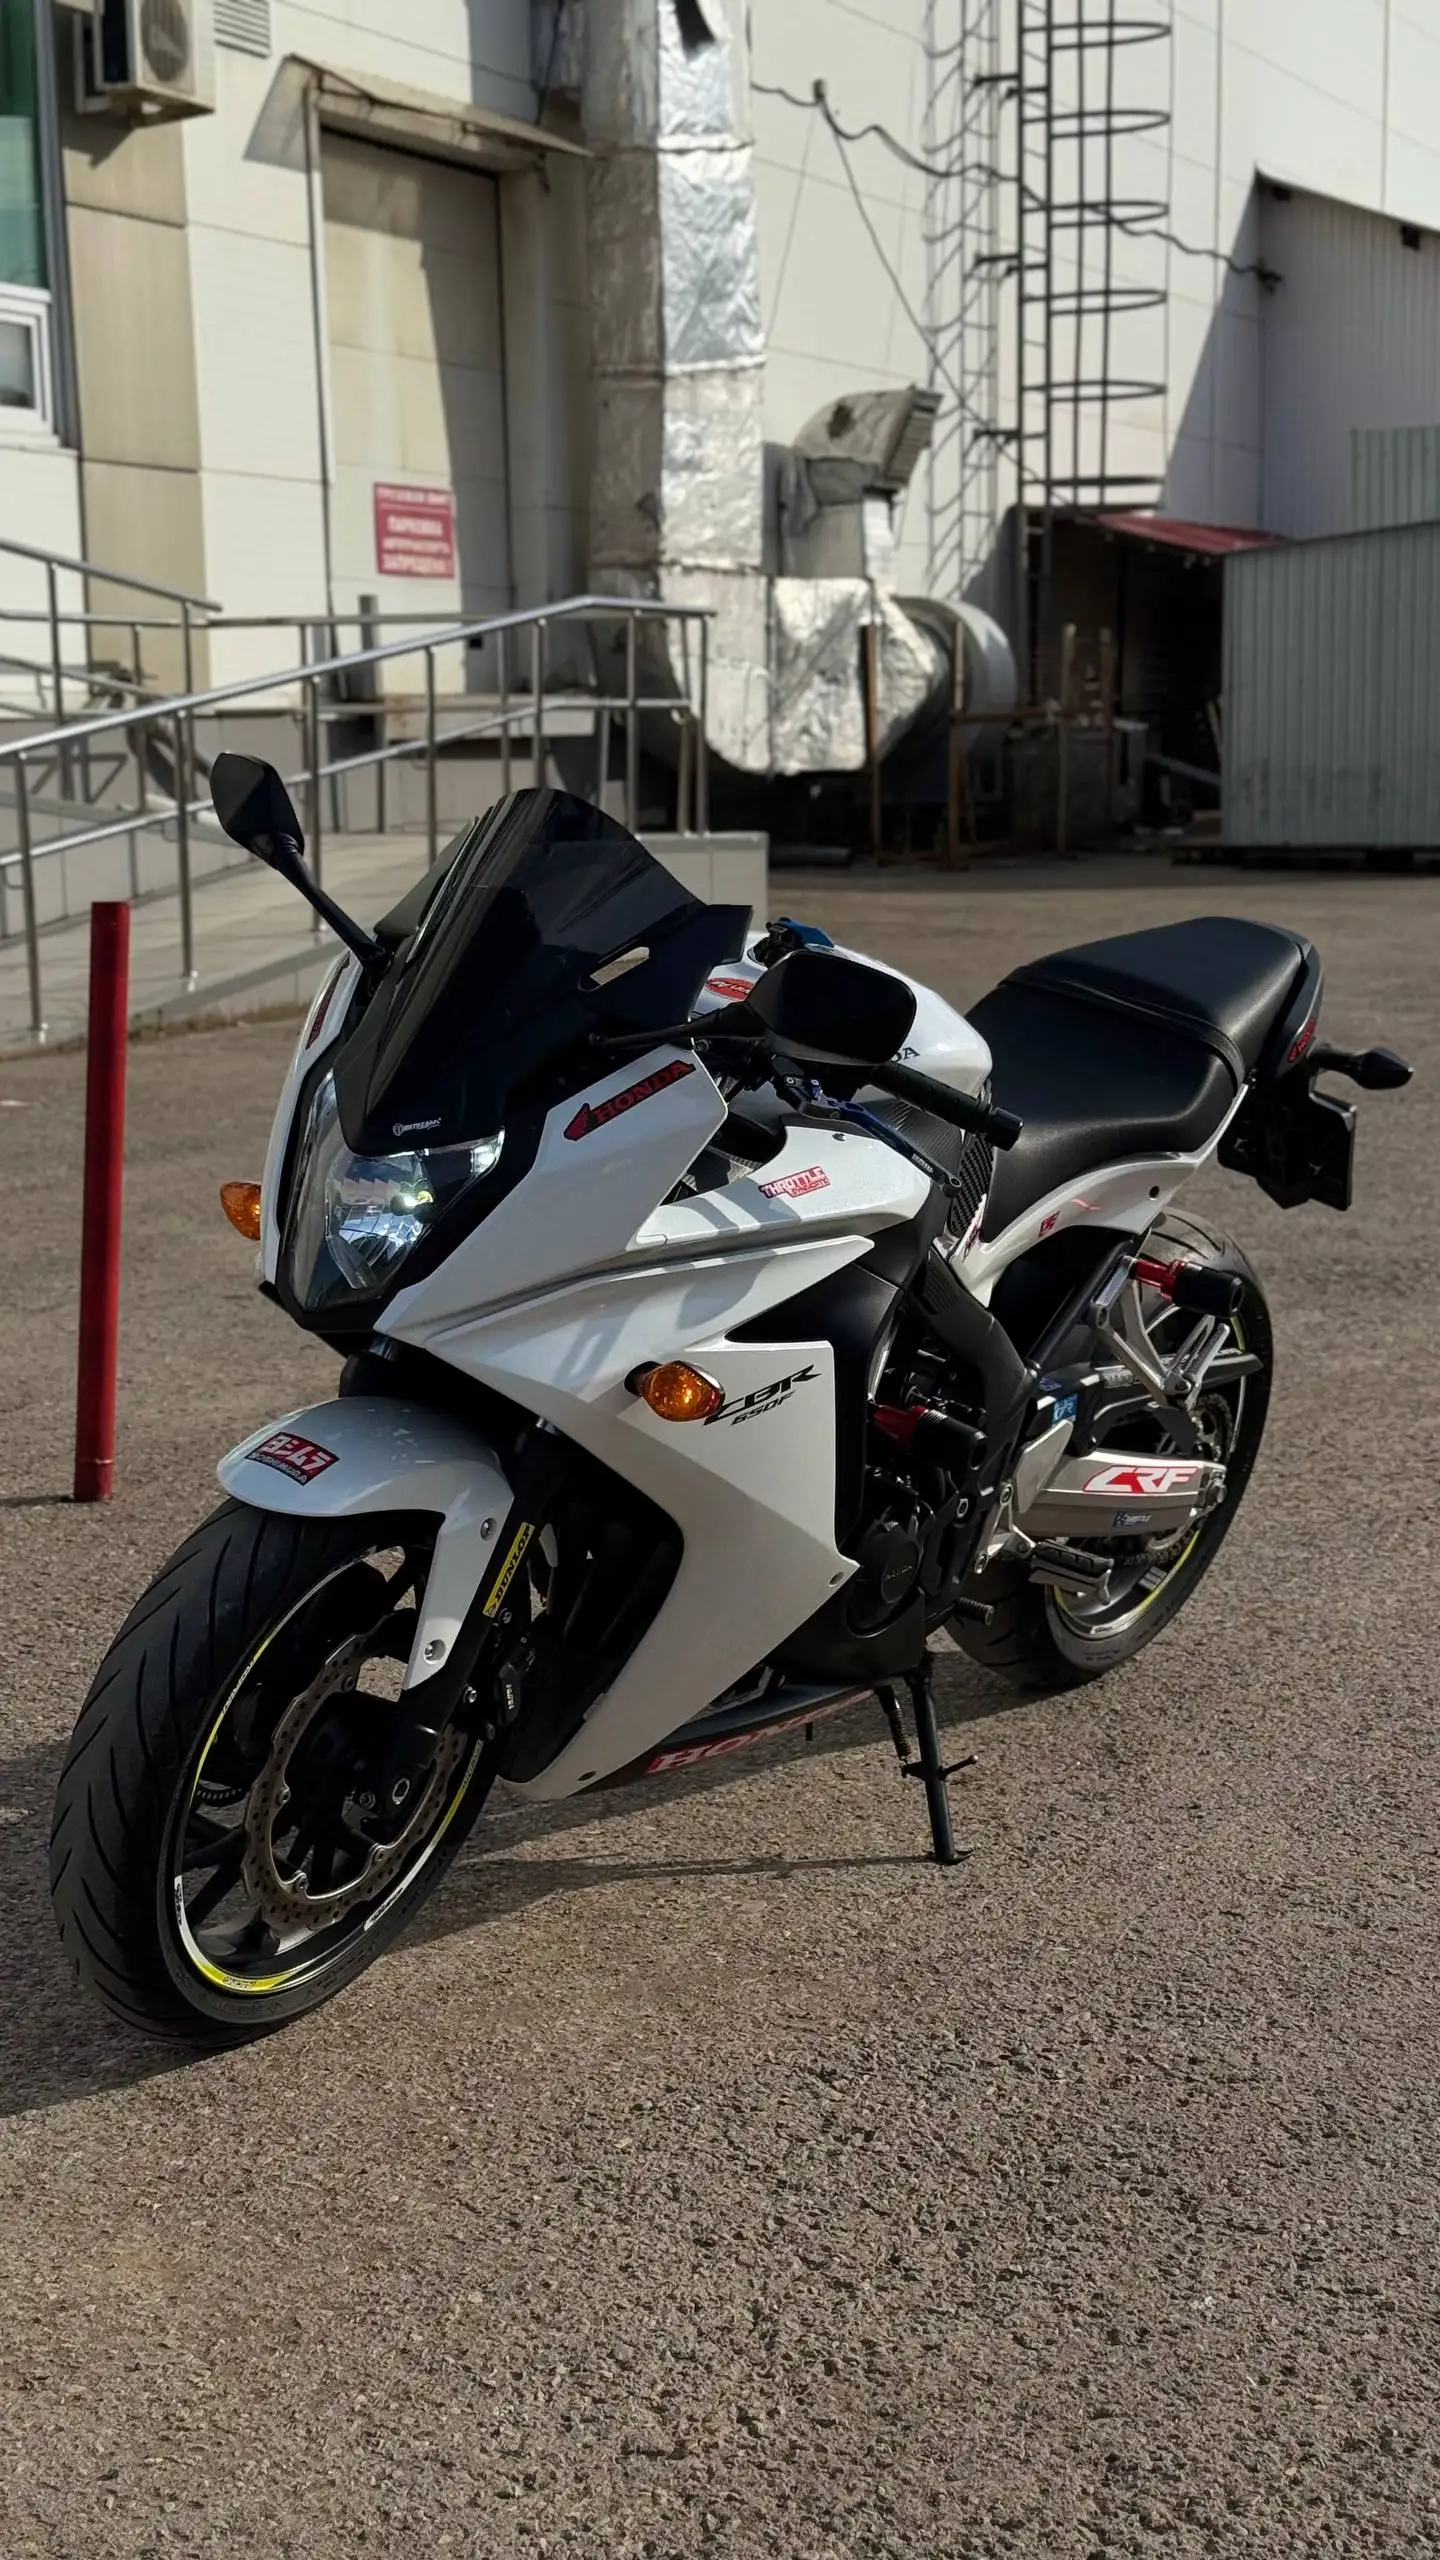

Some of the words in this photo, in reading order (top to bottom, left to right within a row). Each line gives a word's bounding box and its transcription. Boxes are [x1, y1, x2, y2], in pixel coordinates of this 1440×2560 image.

[591, 1061, 692, 1122] HONDA
[760, 1167, 826, 1197] THROTTLE
[703, 1364, 822, 1425] CBR
[730, 1390, 796, 1426] 650F
[260, 1434, 332, 1471] ヨシムラ
[1083, 1466, 1198, 1493] CRF
[494, 1525, 531, 1603] DUNLOP
